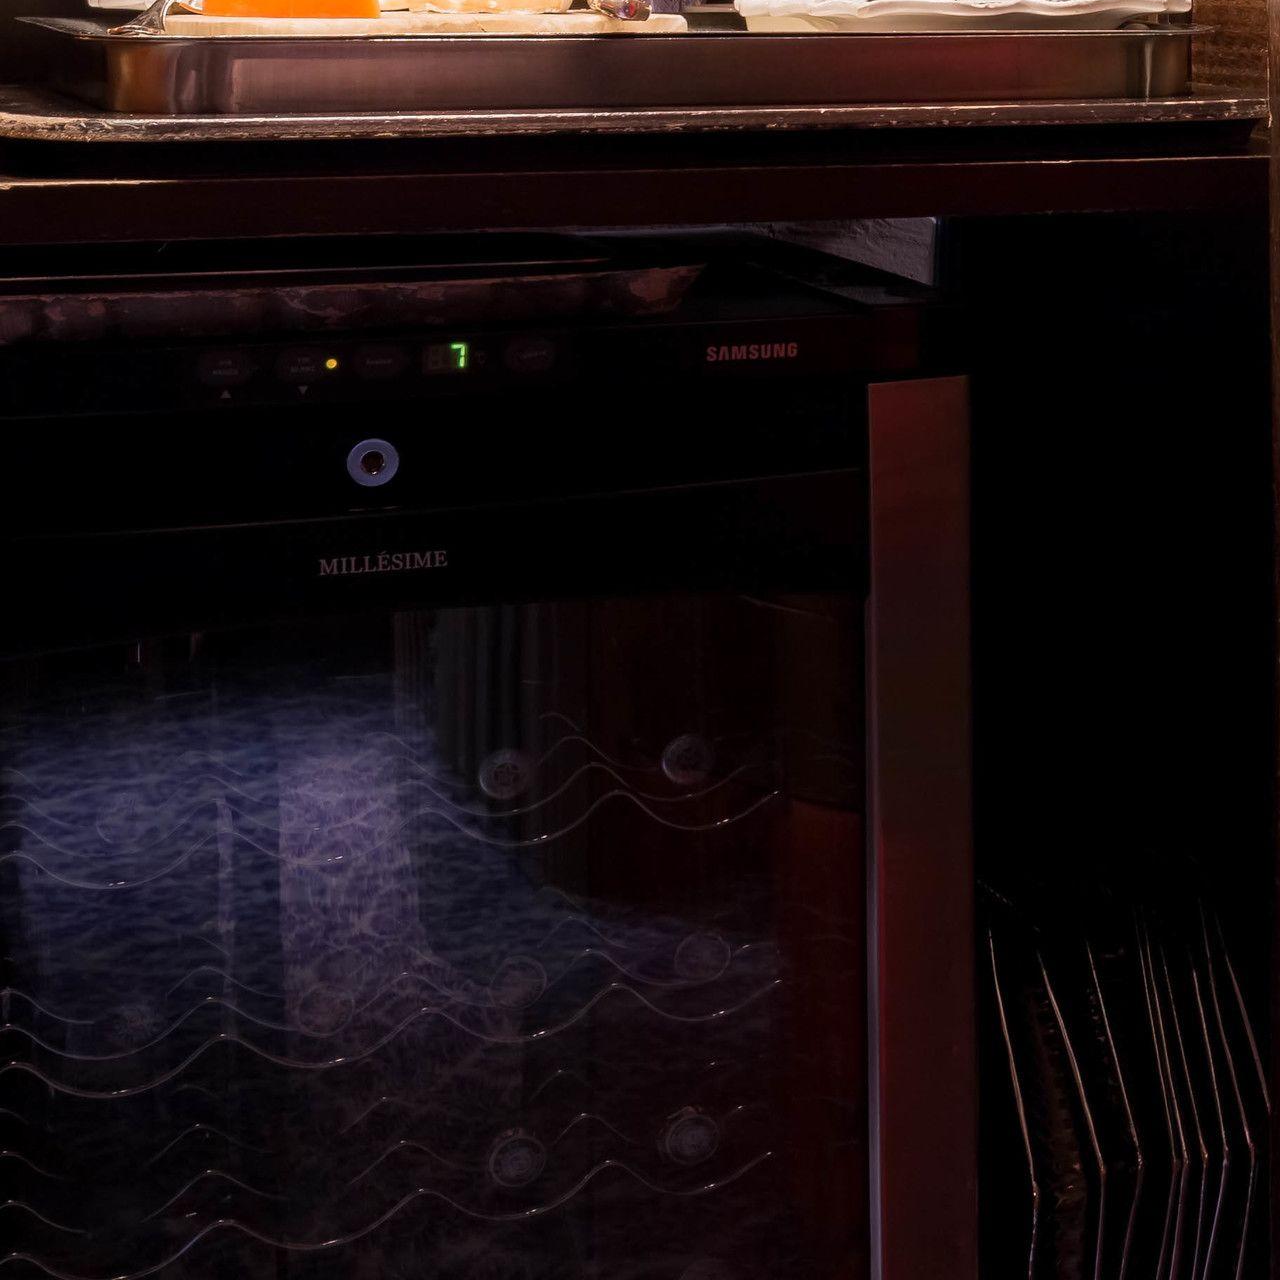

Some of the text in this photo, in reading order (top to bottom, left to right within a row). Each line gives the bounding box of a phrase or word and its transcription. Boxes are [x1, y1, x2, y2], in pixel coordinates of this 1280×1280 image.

[450, 342, 467, 368] 7
[706, 341, 800, 362] SAMSUNG
[318, 549, 449, 577] MILLÉSIME
